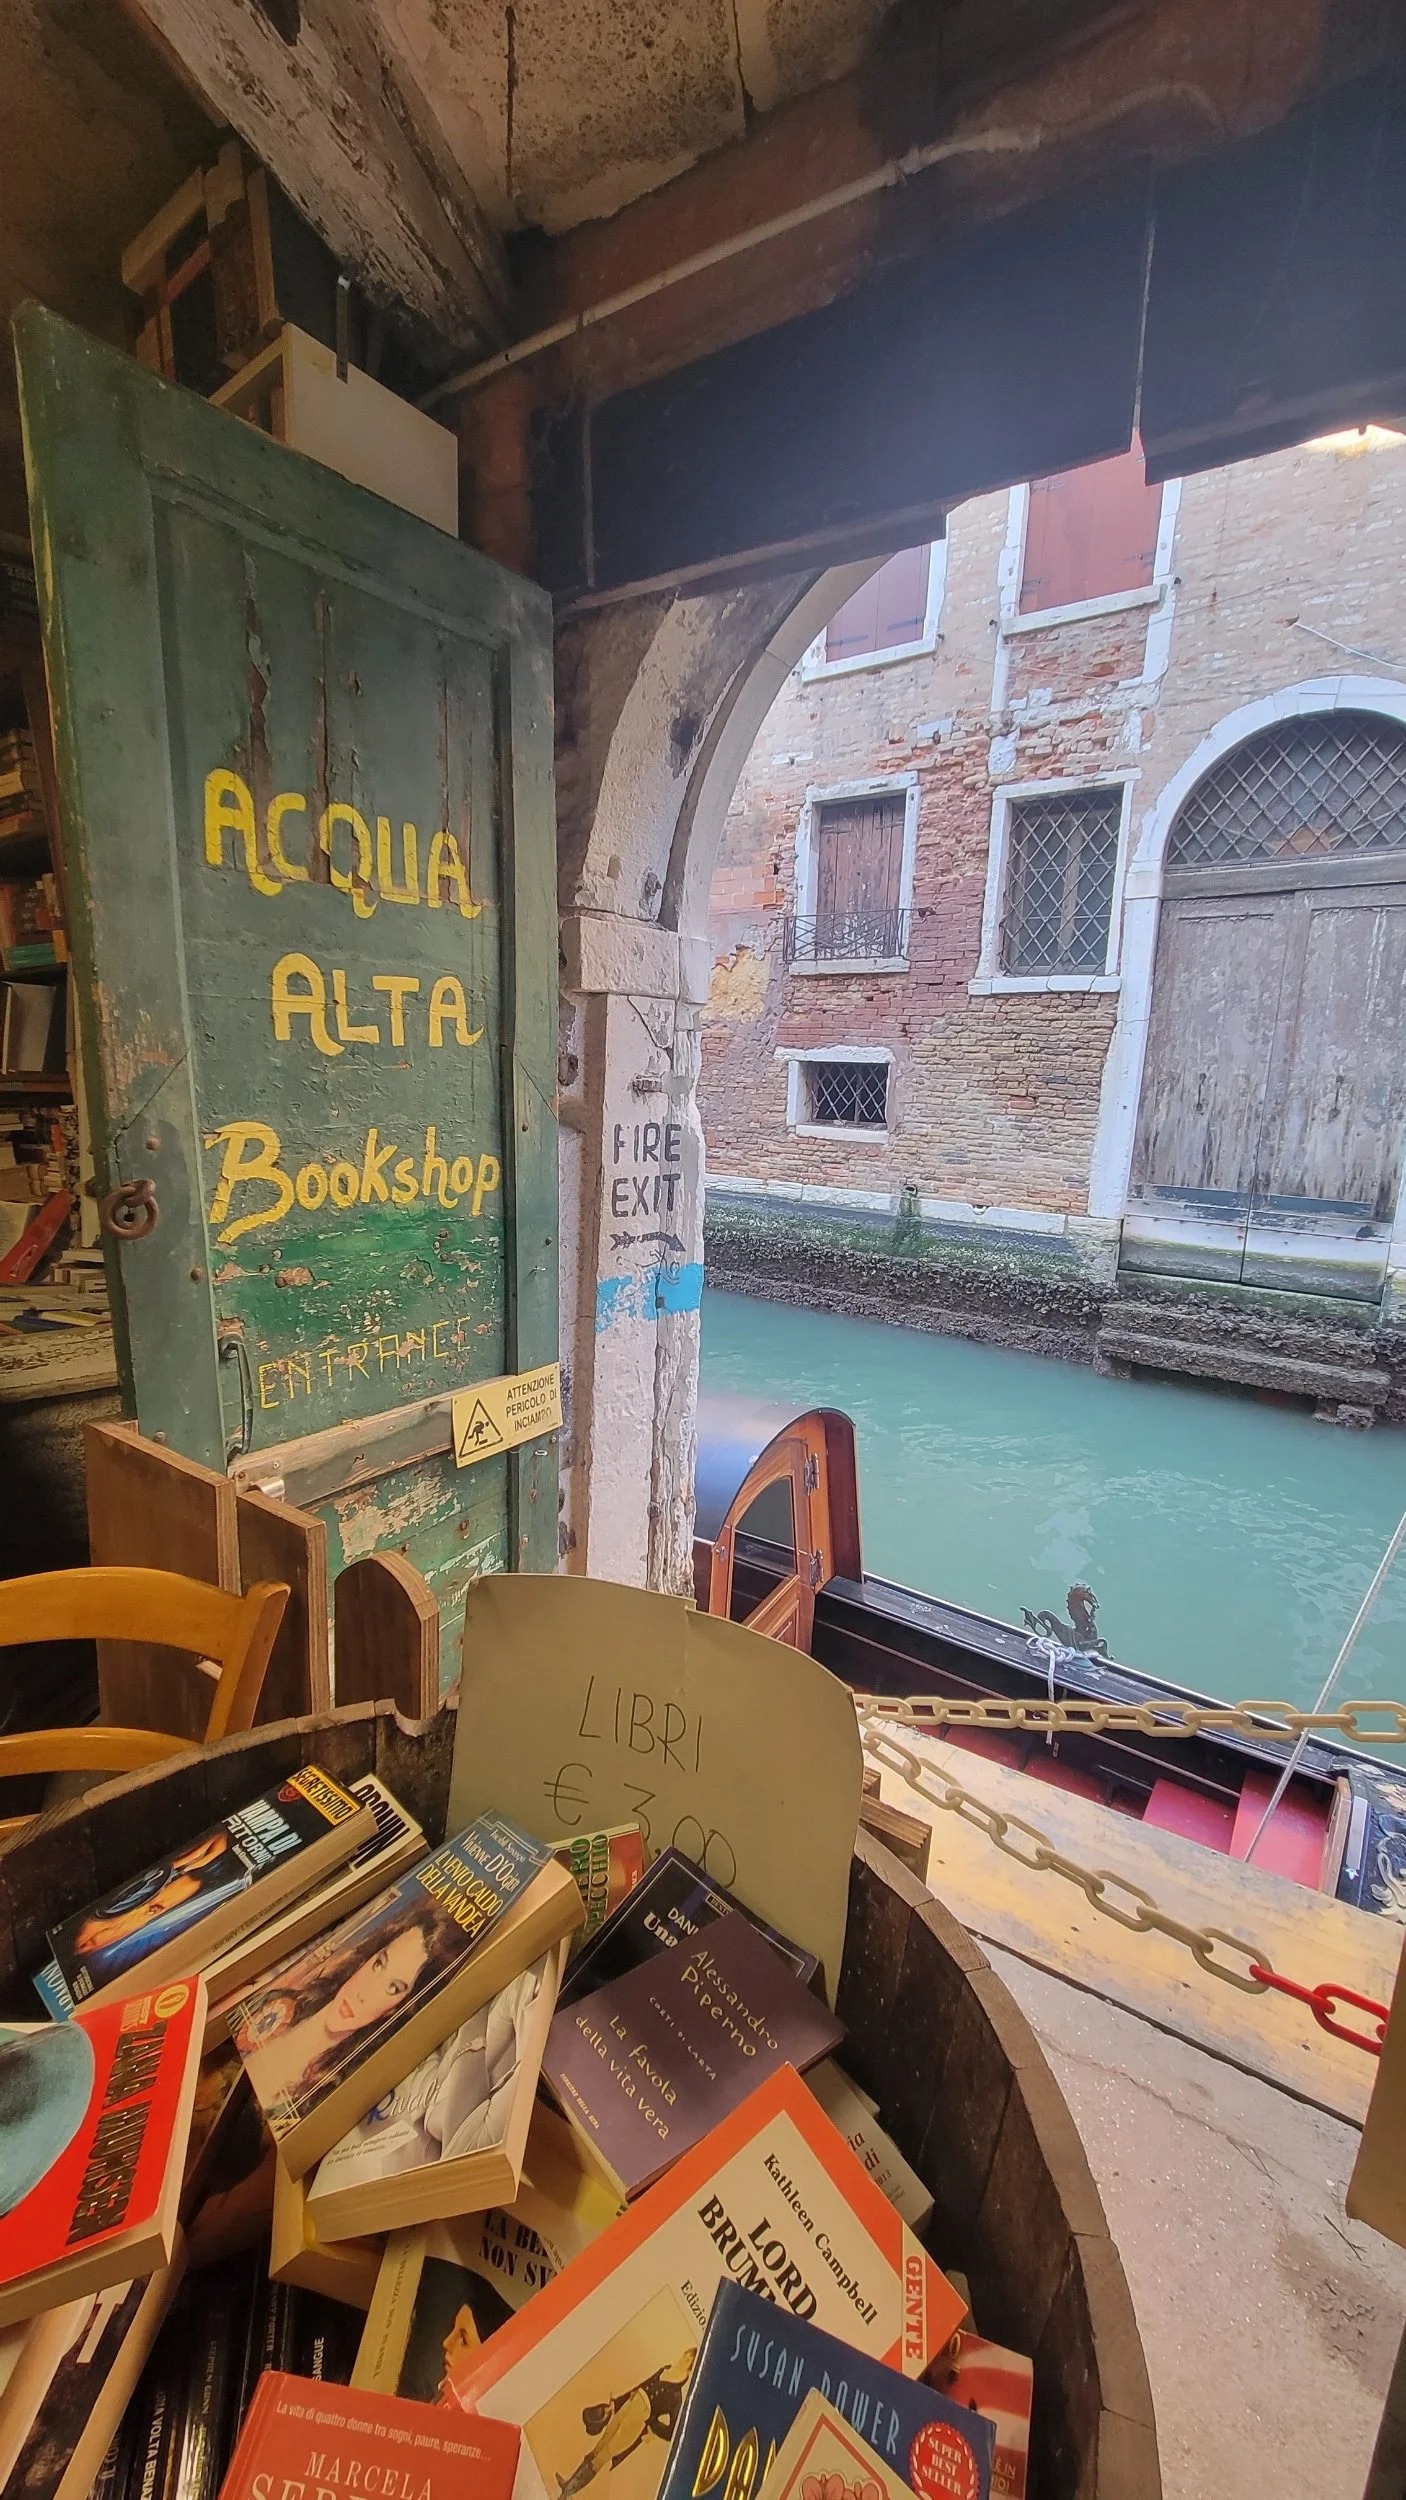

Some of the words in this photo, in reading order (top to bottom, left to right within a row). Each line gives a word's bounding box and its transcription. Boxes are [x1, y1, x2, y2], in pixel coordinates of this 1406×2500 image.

[203, 767, 481, 919] ACQUA
[272, 952, 484, 1056] ALTA
[613, 1123, 682, 1164] FIRE
[201, 1120, 500, 1245] Bookshop
[611, 1173, 681, 1218] EXIT
[258, 1316, 471, 1410] ENTRANCE
[507, 1373, 554, 1400] ATTENZIONE
[505, 1393, 546, 1418] PERICOLO
[549, 1388, 557, 1400] DI
[514, 1407, 552, 1431] INCIAMPO
[578, 1675, 702, 1772] LIBRI
[293, 1768, 354, 1821] SEGRETISSIMO
[543, 1762, 592, 1826] €
[221, 1814, 273, 1864] RITORNO
[272, 1832, 303, 1856] DI
[416, 1863, 452, 1900] DELLA
[441, 1887, 486, 1938] VANDEA
[434, 1850, 450, 1866] IL
[443, 1854, 474, 1887] VENTO
[466, 1880, 504, 1917] CALDO
[643, 1911, 679, 1948] Una
[649, 1997, 675, 2028] CORTI
[680, 1965, 757, 2057] Piperno
[690, 1951, 778, 2050] Alessandro
[575, 2016, 607, 2059] della
[609, 2059, 636, 2098] vita
[637, 2097, 669, 2140] vera
[609, 2015, 627, 2041] La
[628, 2044, 677, 2106] favola
[478, 2235, 518, 2277] NON
[763, 2152, 815, 2234] Kathleen
[814, 2233, 878, 2327] Campbell
[747, 2217, 817, 2321] LORD
[680, 2280, 708, 2331] Edizio
[904, 2256, 924, 2361] GENTE
[730, 2324, 805, 2397] SUSAN
[820, 2370, 900, 2456] POWER
[147, 2416, 164, 2460] VOLTA
[276, 2401, 288, 2414] La
[289, 2402, 305, 2417] vita
[306, 2406, 315, 2420] di
[316, 2408, 346, 2428] quattro
[346, 2417, 373, 2435] donne
[374, 2423, 386, 2437] tra
[388, 2426, 413, 2446] sogni,
[414, 2434, 441, 2452] paure,
[928, 2436, 962, 2464] SUPER
[304, 2450, 432, 2500] MARCELA
[922, 2464, 962, 2496] SELLER
[931, 2453, 957, 2477] BEST
